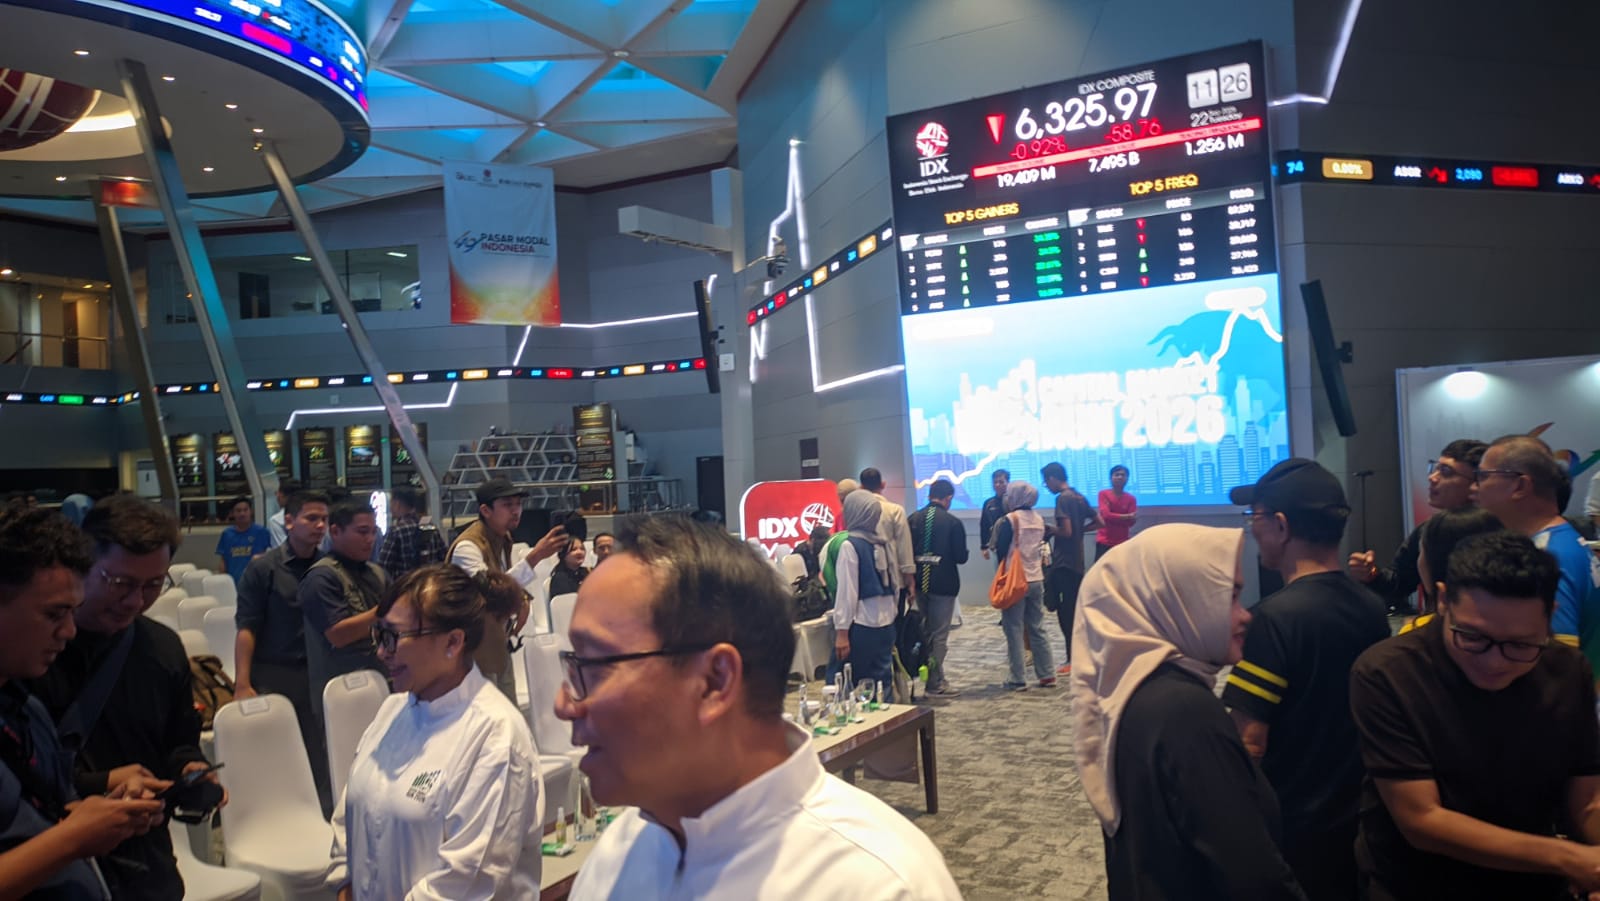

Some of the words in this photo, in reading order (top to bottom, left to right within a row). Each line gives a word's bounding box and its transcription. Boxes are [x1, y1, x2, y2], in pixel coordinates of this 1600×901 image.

[1078, 82, 1096, 95] IDX
[1096, 70, 1156, 91] COMPOSITE
[1192, 78, 1213, 100] 11
[1223, 72, 1248, 95] 26
[1015, 82, 1158, 140] 6,325.97
[1104, 117, 1163, 143] -58.76
[1227, 132, 1245, 150] M
[1010, 136, 1068, 160] -0.92%
[1128, 151, 1140, 166] B
[920, 158, 950, 177] IDX
[1041, 165, 1056, 181] M
[1128, 181, 1153, 196] TOP
[1154, 178, 1165, 192] 5
[1165, 173, 1199, 190] FREQ
[944, 211, 966, 225] TOP
[966, 209, 975, 221] 5
[975, 202, 1019, 219] GAINERS
[481, 233, 514, 243] PASAR
[516, 236, 551, 246] MODAL
[481, 242, 536, 253] INDONESIA
[1121, 394, 1225, 447] 2026
[758, 516, 800, 540] IDX
